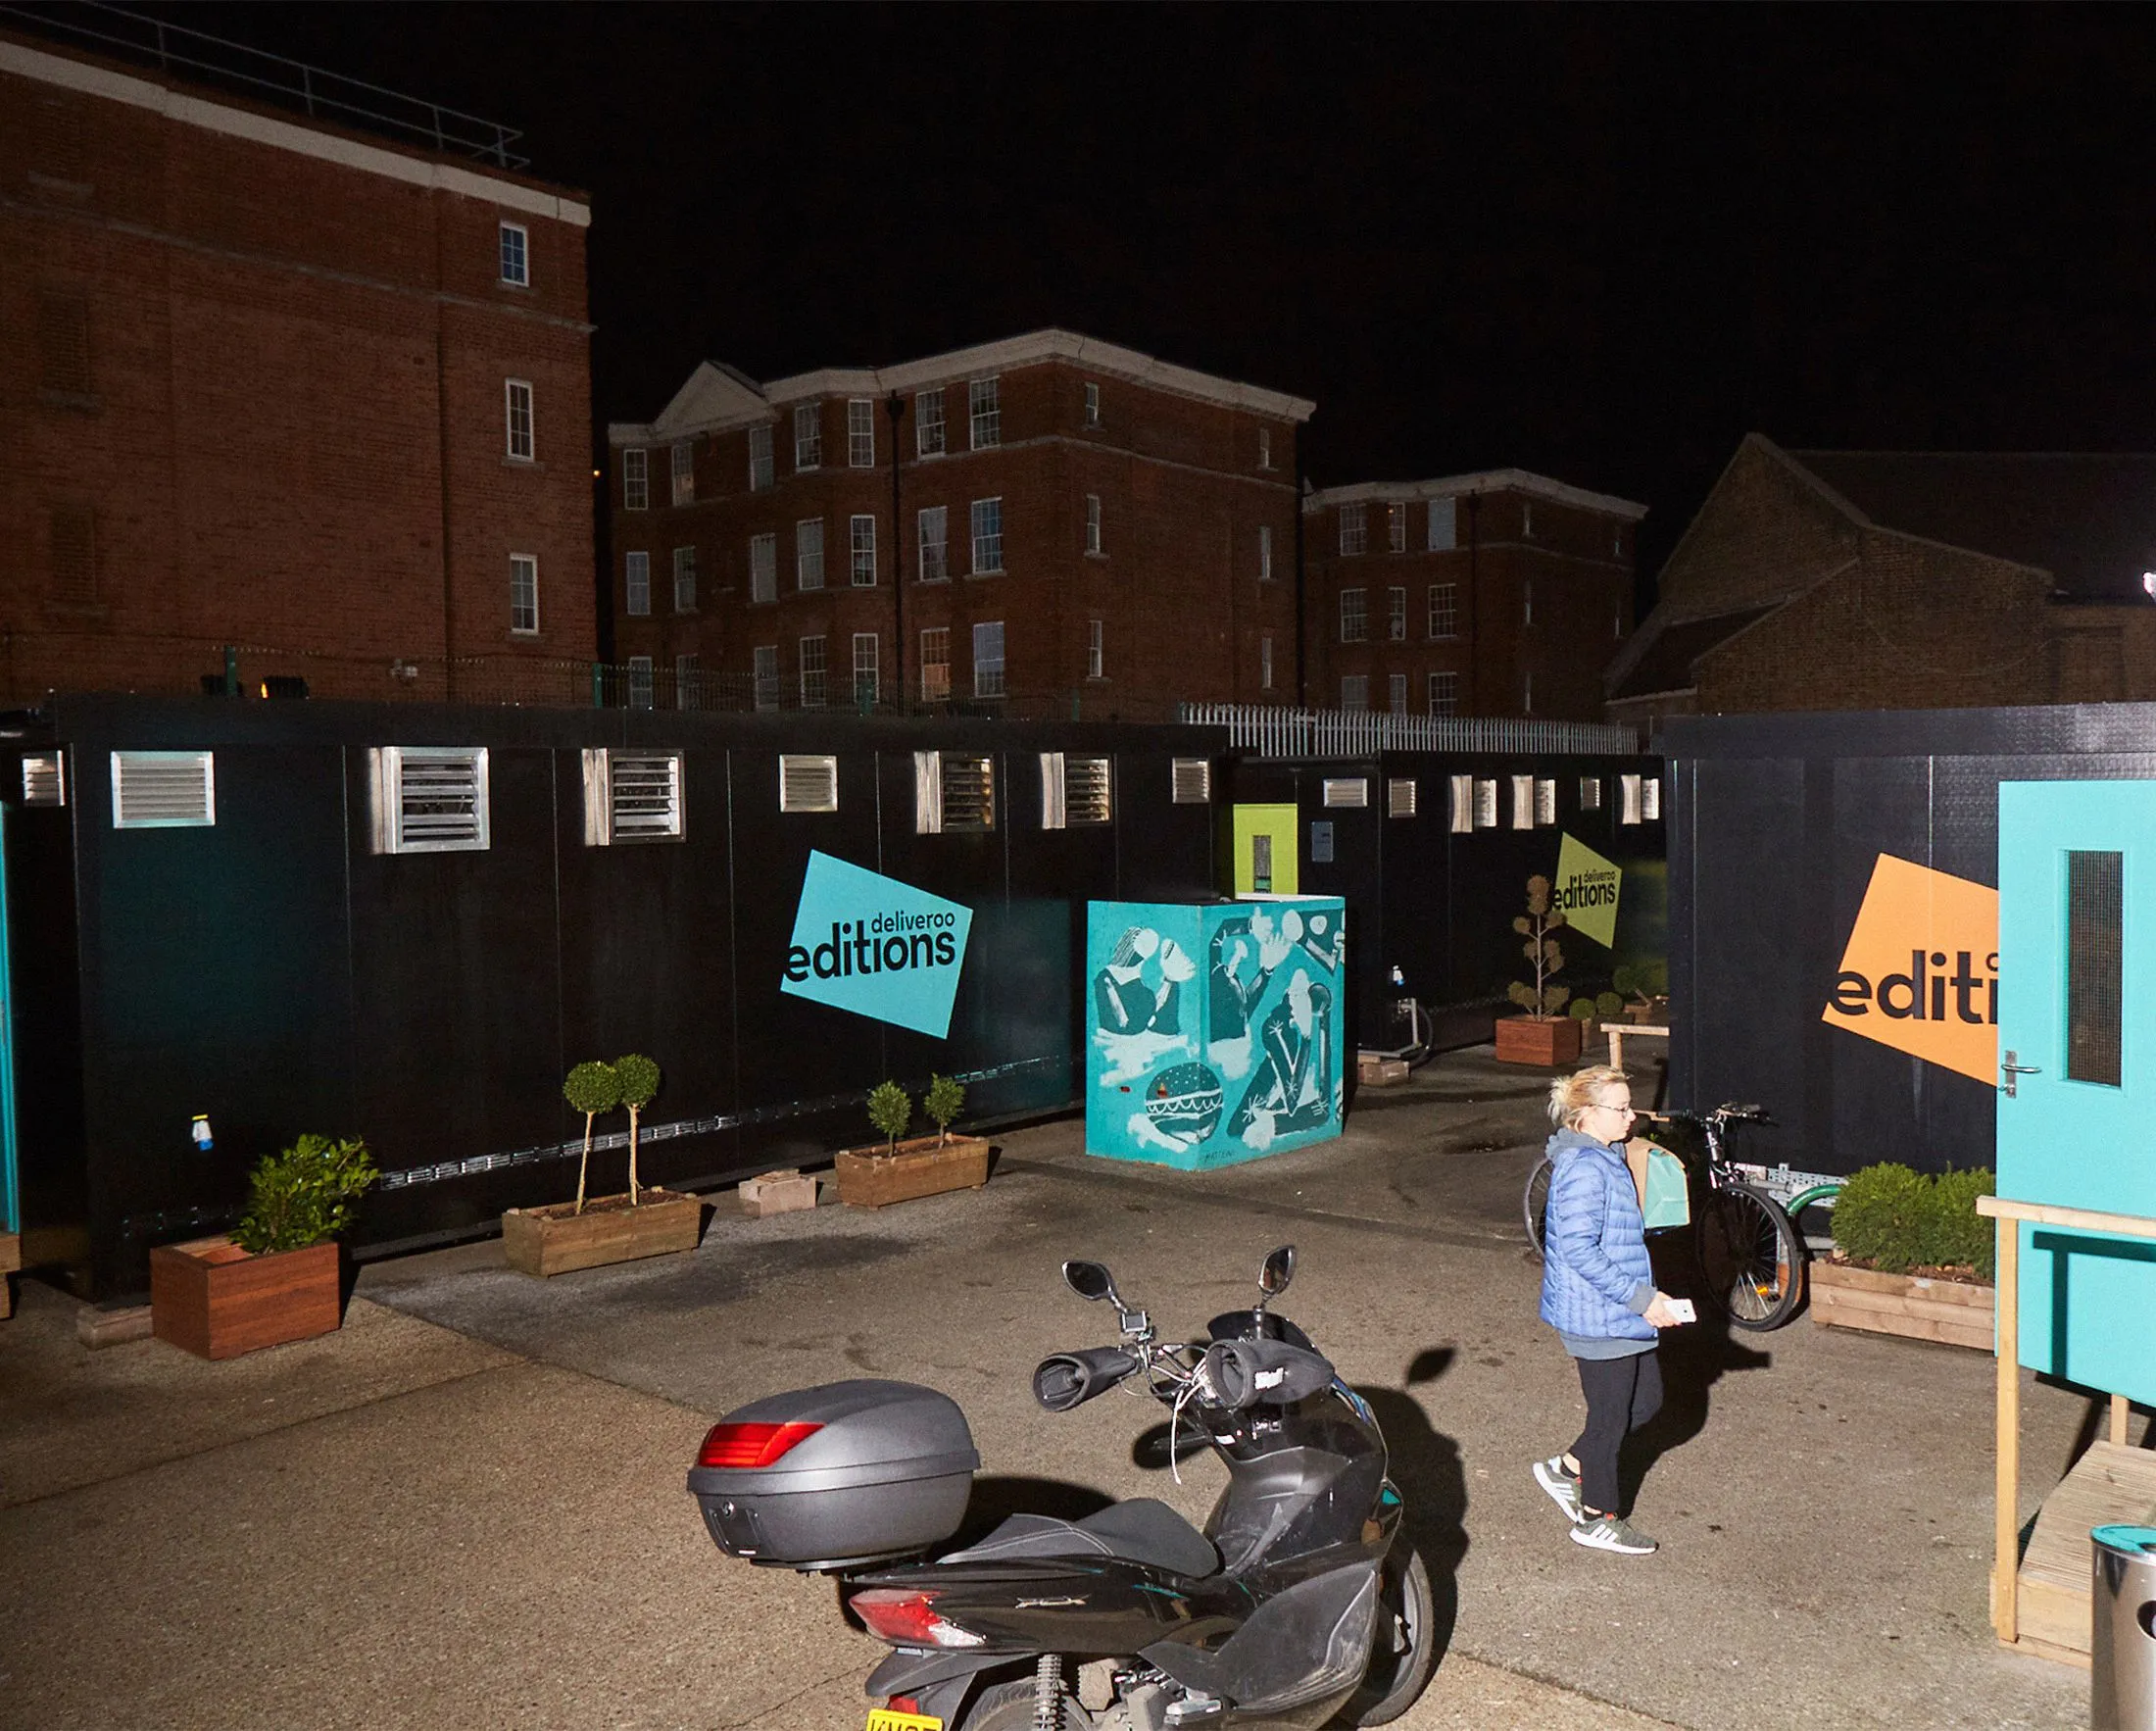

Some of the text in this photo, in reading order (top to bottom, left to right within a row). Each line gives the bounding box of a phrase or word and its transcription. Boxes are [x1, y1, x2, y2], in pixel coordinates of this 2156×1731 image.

[1584, 868, 1615, 883] deliveroo
[1552, 874, 1615, 910] editions
[871, 911, 955, 933] deliveroo
[784, 919, 955, 982] editions
